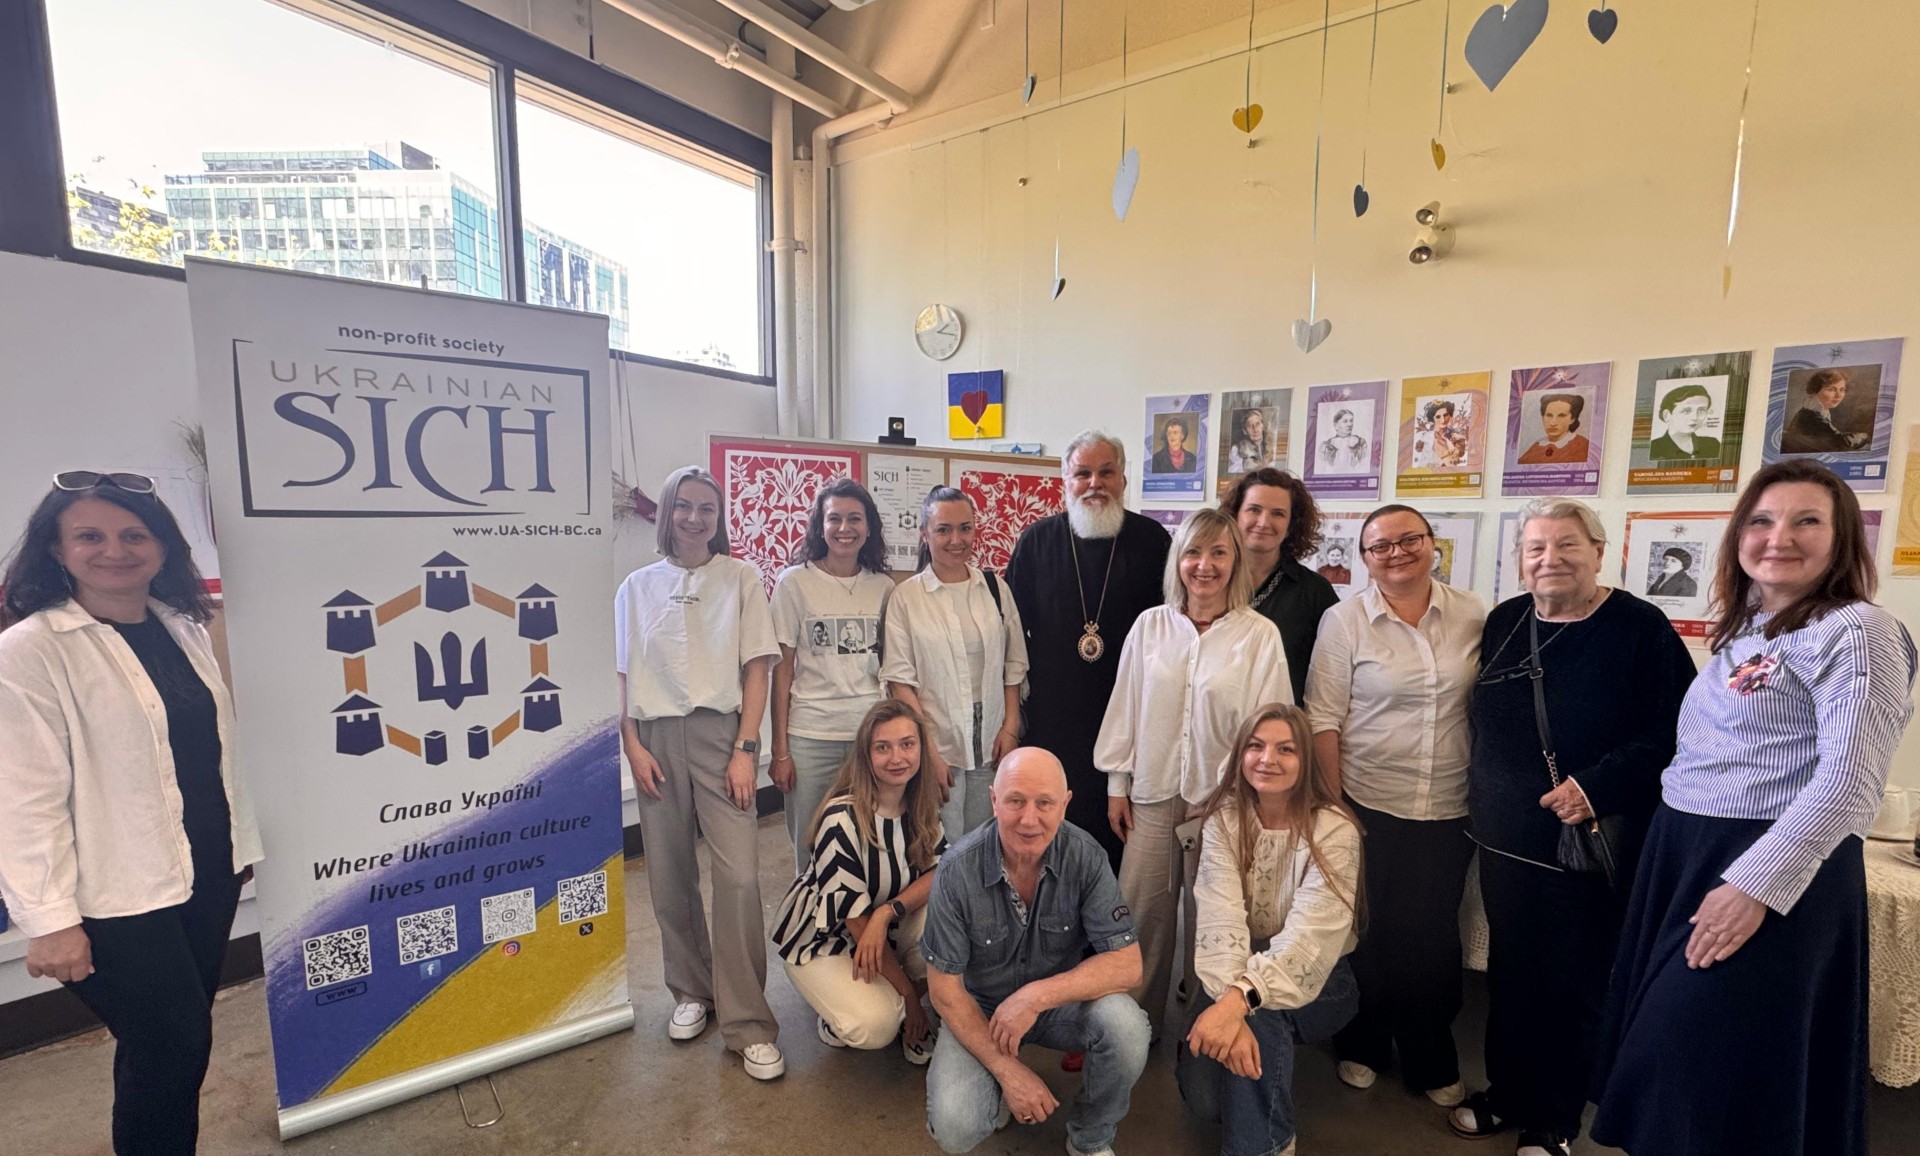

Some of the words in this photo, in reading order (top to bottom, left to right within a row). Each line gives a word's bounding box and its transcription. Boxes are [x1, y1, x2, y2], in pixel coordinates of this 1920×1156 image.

[338, 324, 437, 347] non-profit
[442, 337, 505, 357] society
[270, 359, 553, 404] UKRAINIAN
[273, 391, 556, 507] SICH
[873, 470, 899, 483] SICH
[452, 524, 602, 537] www.UA-SICH-BC.ca
[379, 799, 452, 824] Слава
[461, 780, 543, 811] Україні
[313, 850, 394, 881] Where
[402, 830, 511, 863] Ukrainian
[519, 814, 592, 841] culture
[369, 879, 426, 904] lives
[434, 868, 475, 890] and
[483, 854, 546, 881] grows
